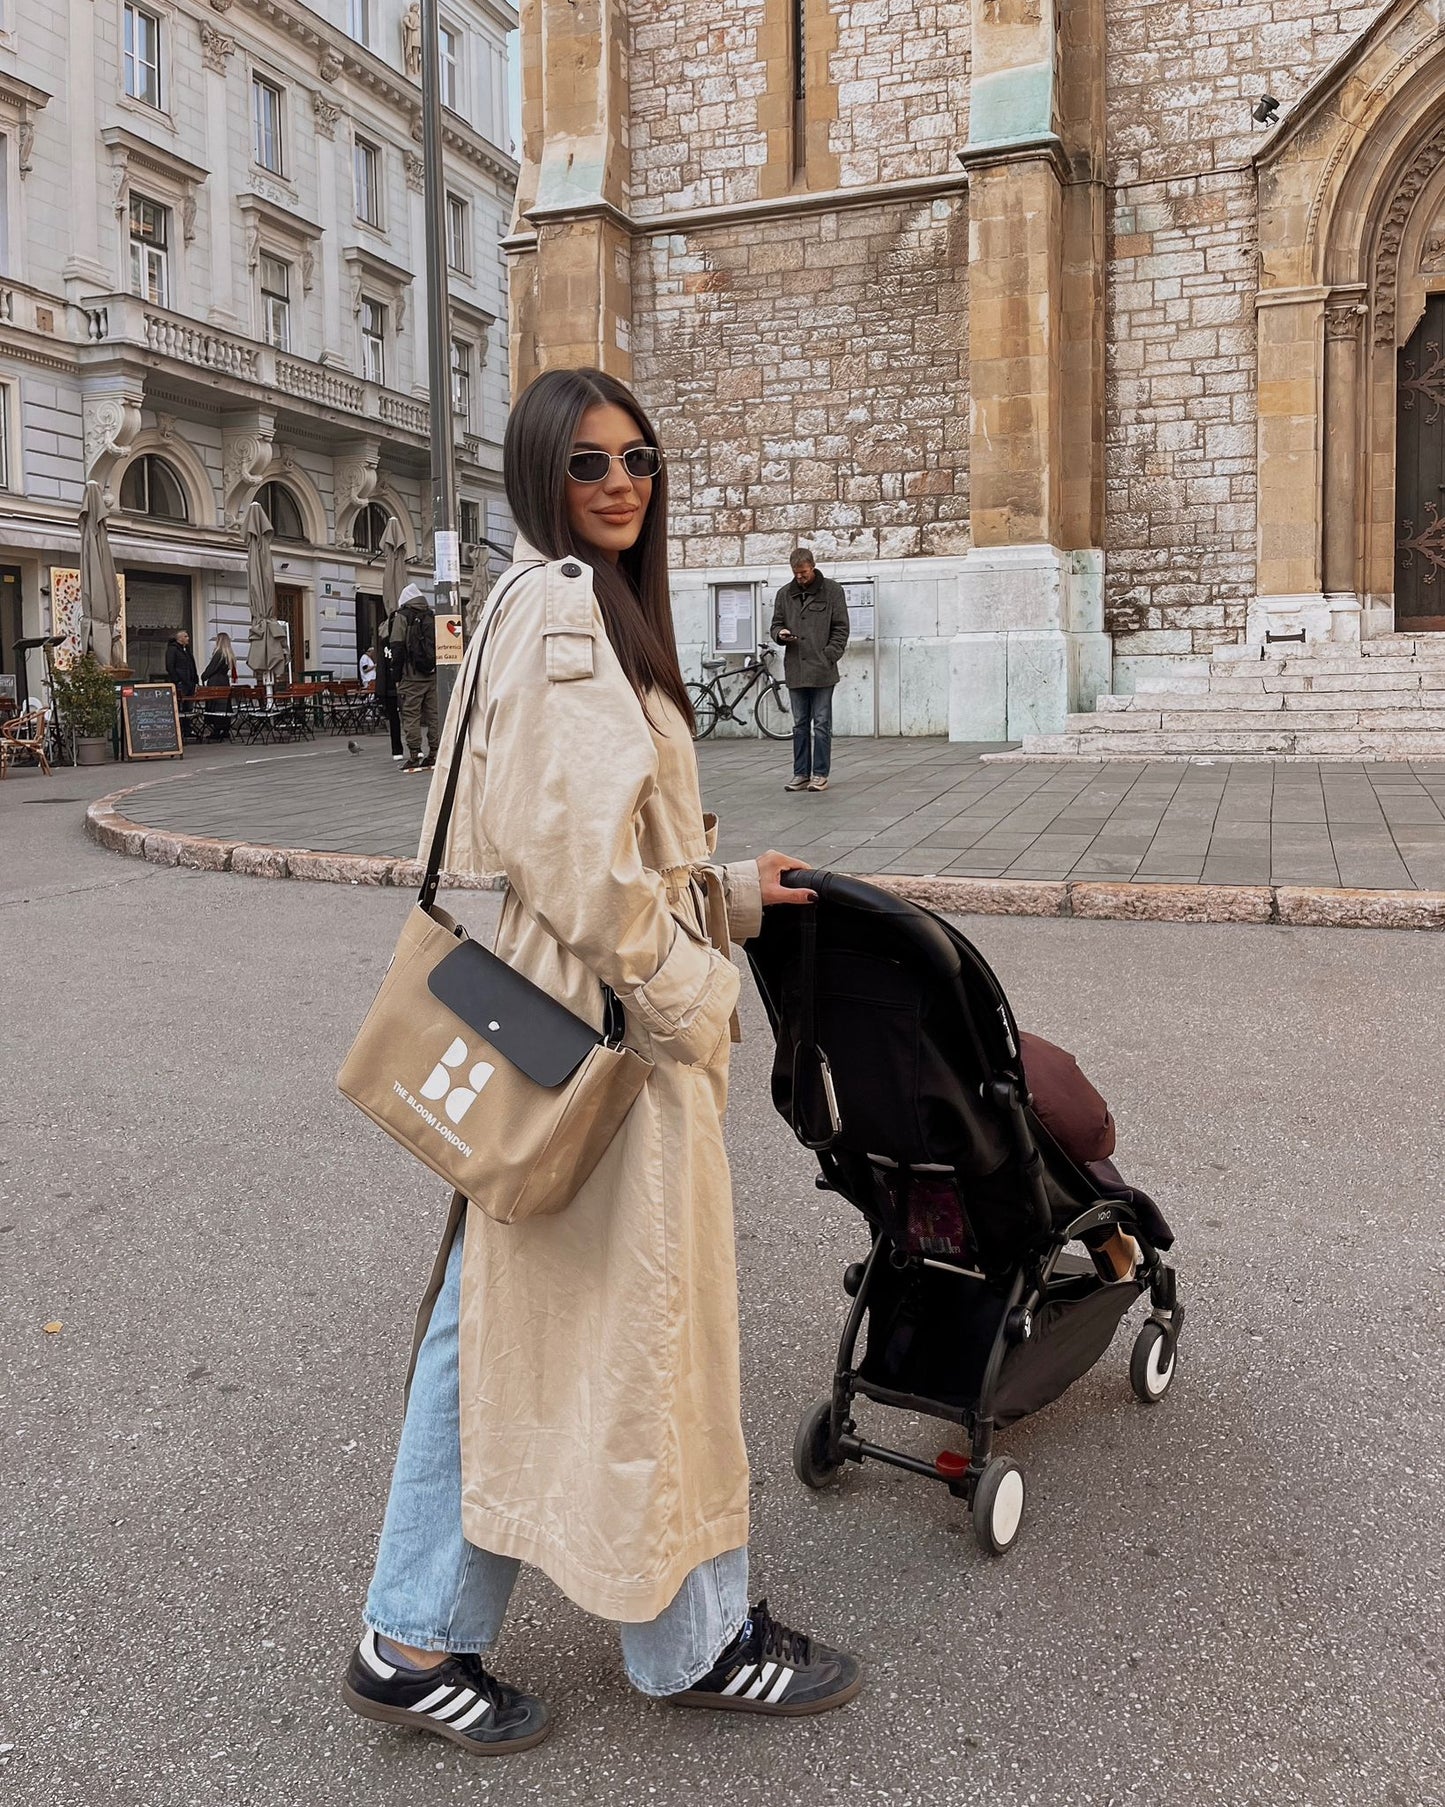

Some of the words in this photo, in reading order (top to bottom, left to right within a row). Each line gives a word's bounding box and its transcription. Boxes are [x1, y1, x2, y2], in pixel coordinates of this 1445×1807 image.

[393, 1080, 410, 1099] THE
[406, 1095, 437, 1126] BLOOM
[435, 1121, 473, 1158] LONDON
